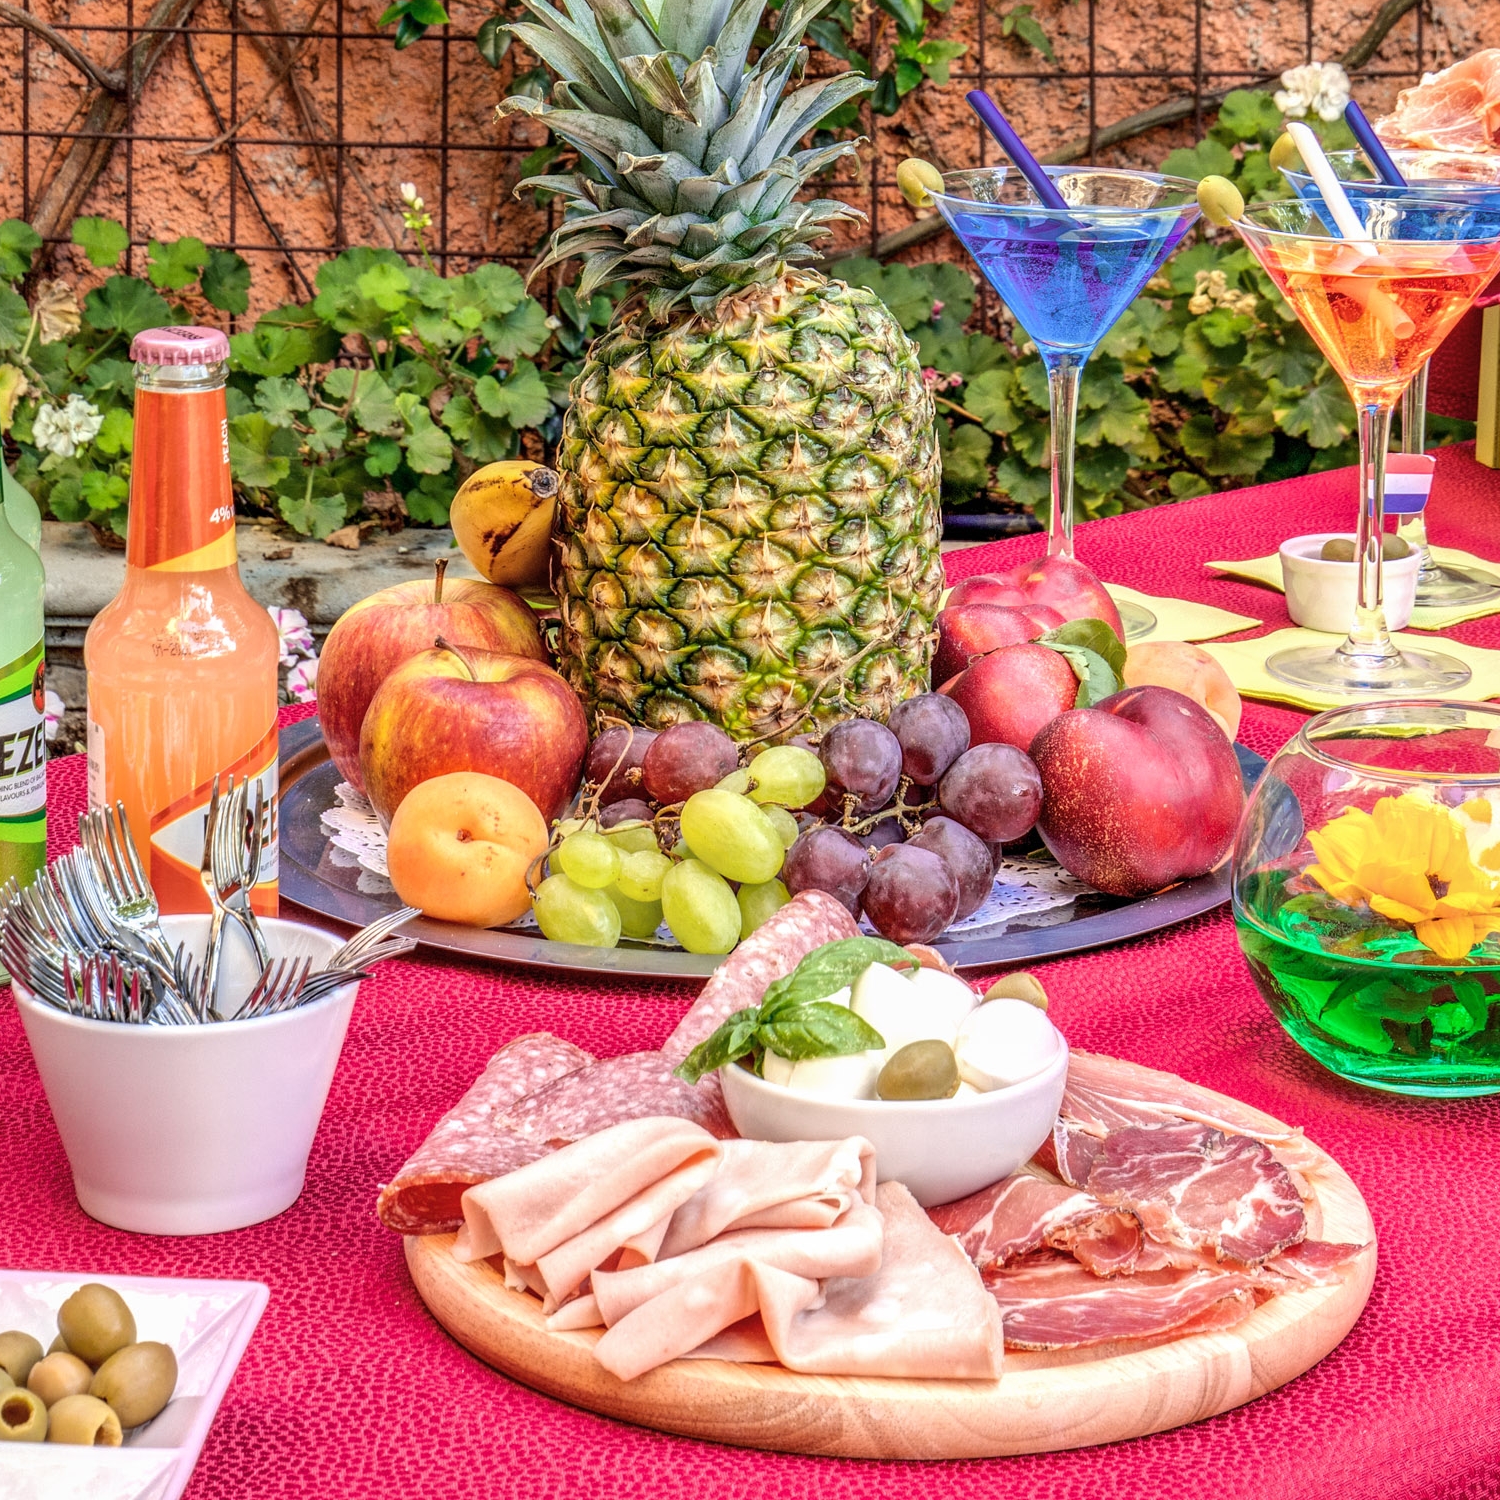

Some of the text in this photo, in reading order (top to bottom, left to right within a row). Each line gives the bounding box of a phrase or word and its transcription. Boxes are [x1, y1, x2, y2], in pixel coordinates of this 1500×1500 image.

[220, 418, 230, 464] PEACH
[210, 506, 231, 525] 4%
[14, 779, 30, 789] BLEND
